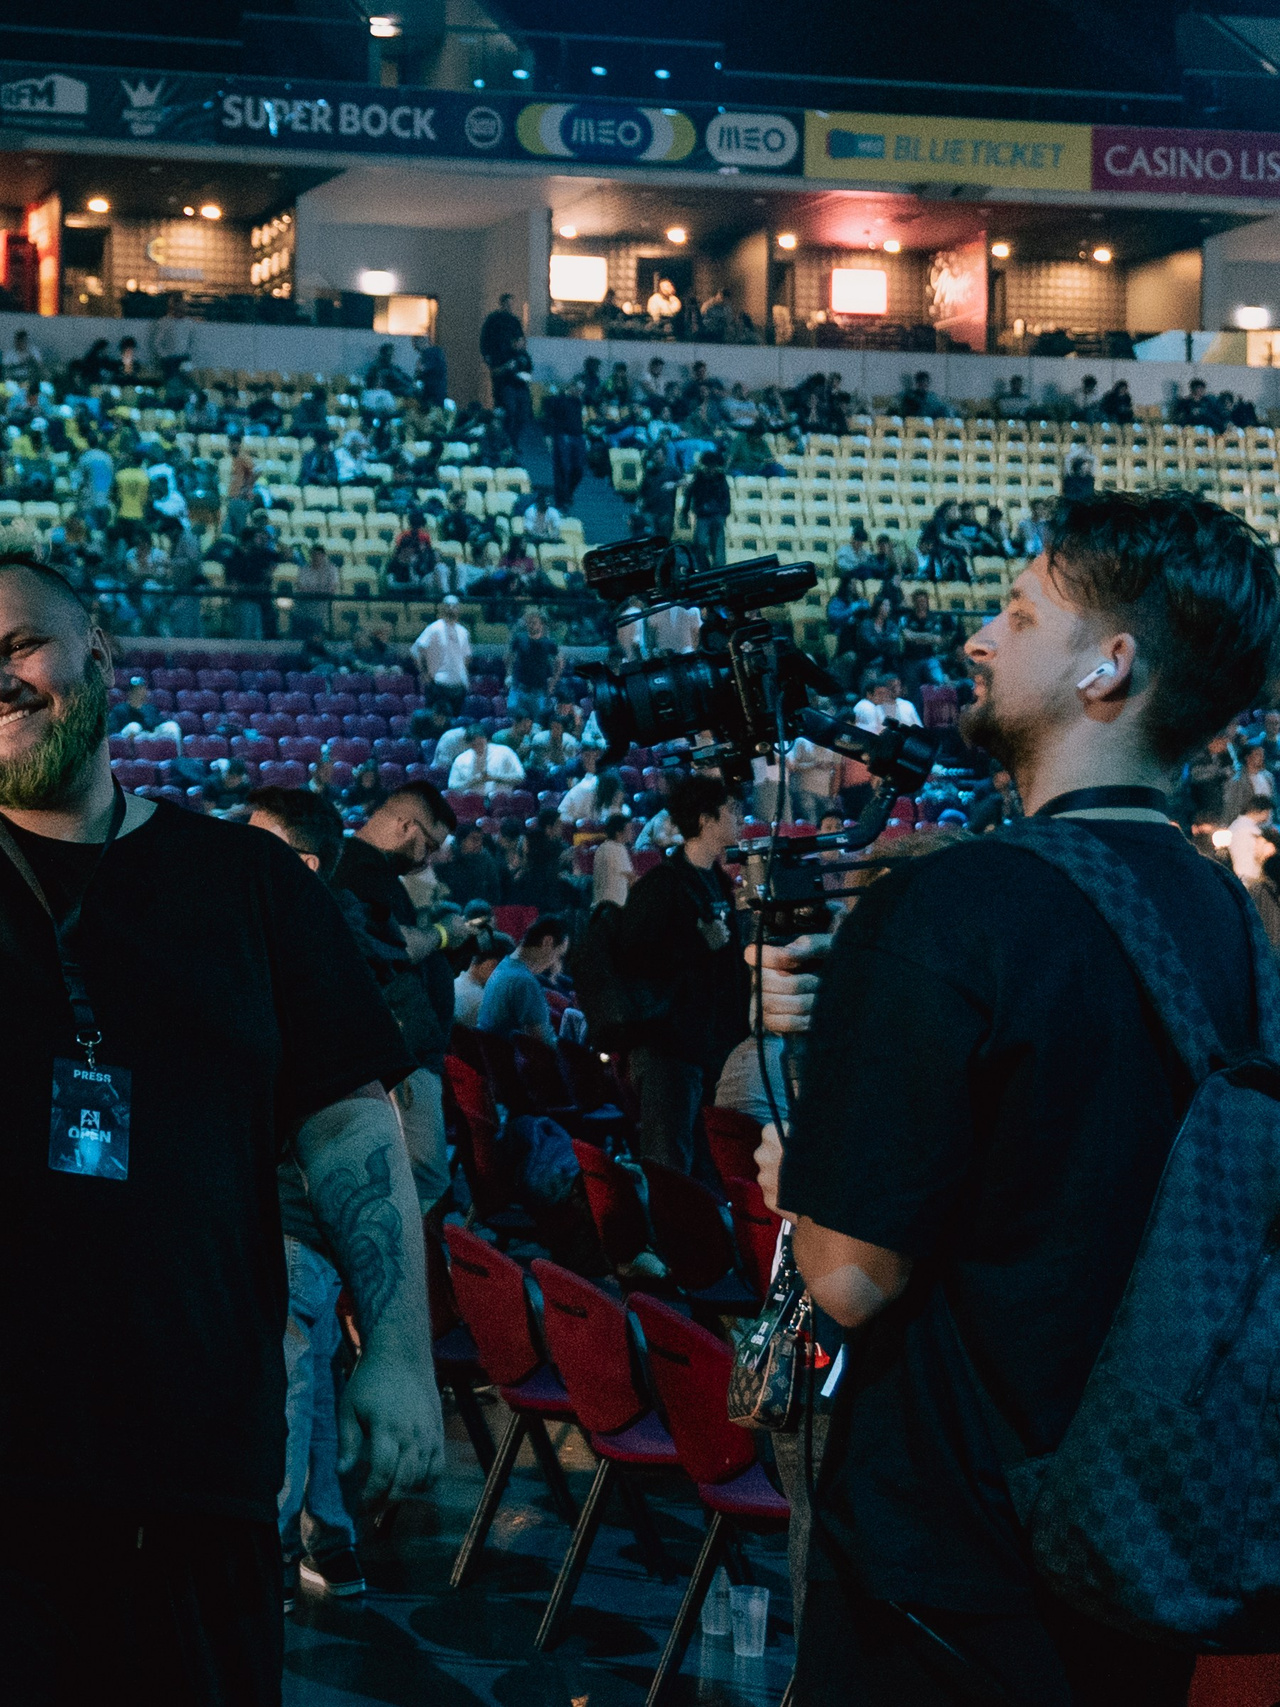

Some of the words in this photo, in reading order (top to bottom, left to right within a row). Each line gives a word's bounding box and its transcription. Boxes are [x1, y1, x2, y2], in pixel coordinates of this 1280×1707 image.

[221, 94, 333, 134] SUPER
[338, 102, 437, 141] BOCK
[571, 117, 642, 148] MEO
[718, 125, 786, 154] MEO
[1104, 144, 1233, 181] CASINO
[73, 1069, 112, 1083] PRESS
[67, 1125, 112, 1144] OPEN
